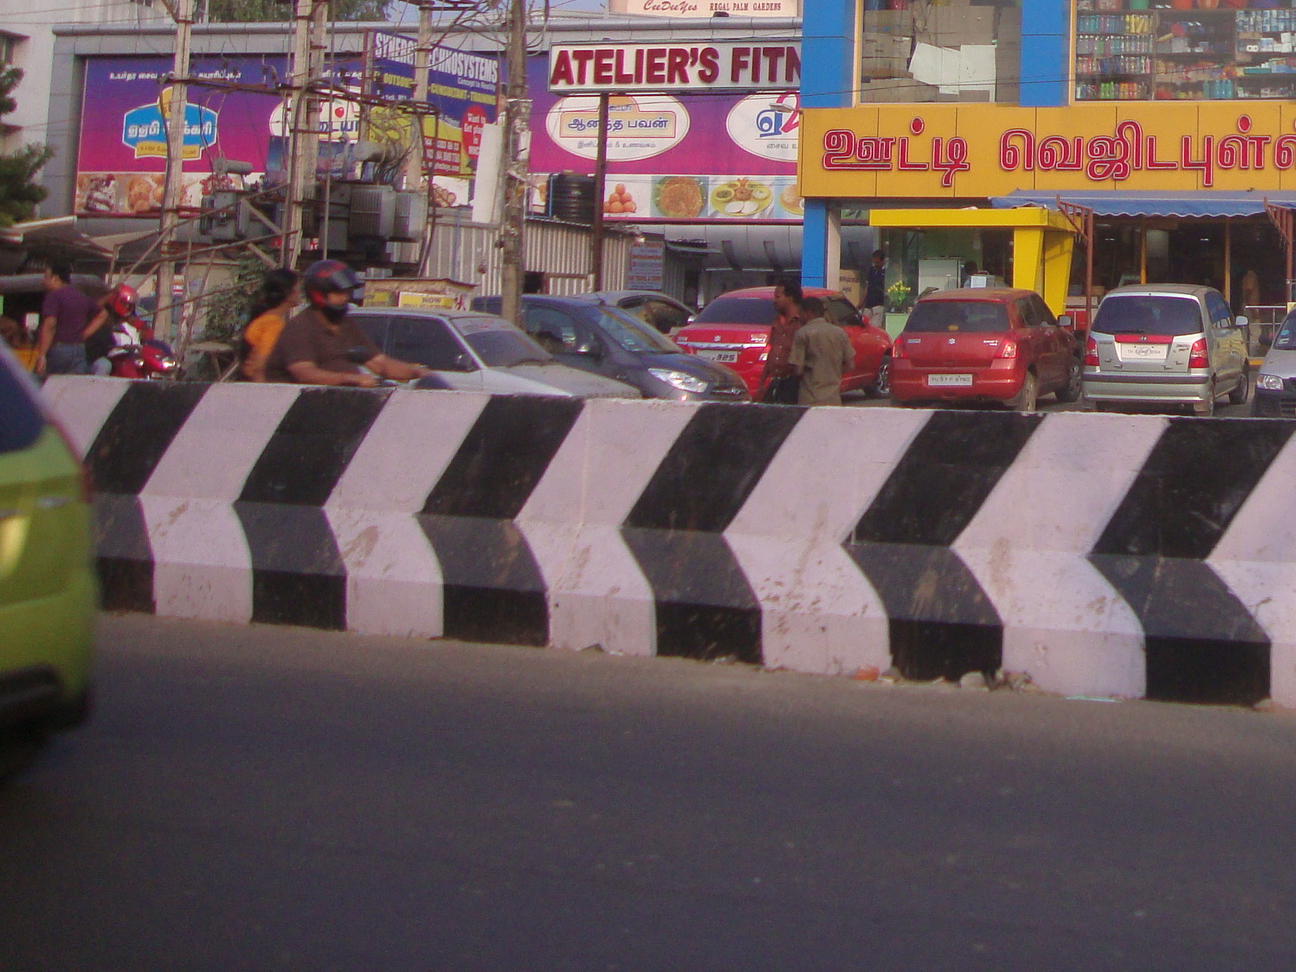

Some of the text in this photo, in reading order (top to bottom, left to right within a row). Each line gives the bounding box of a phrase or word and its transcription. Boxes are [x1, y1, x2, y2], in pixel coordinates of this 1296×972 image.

[709, 2, 730, 12] REGAL
[732, 2, 749, 12] PALM
[752, 2, 782, 12] GARDENS
[550, 46, 720, 86] ATELIER'S
[627, 116, 669, 129] பவன்
[822, 115, 971, 187] ஊட்டி
